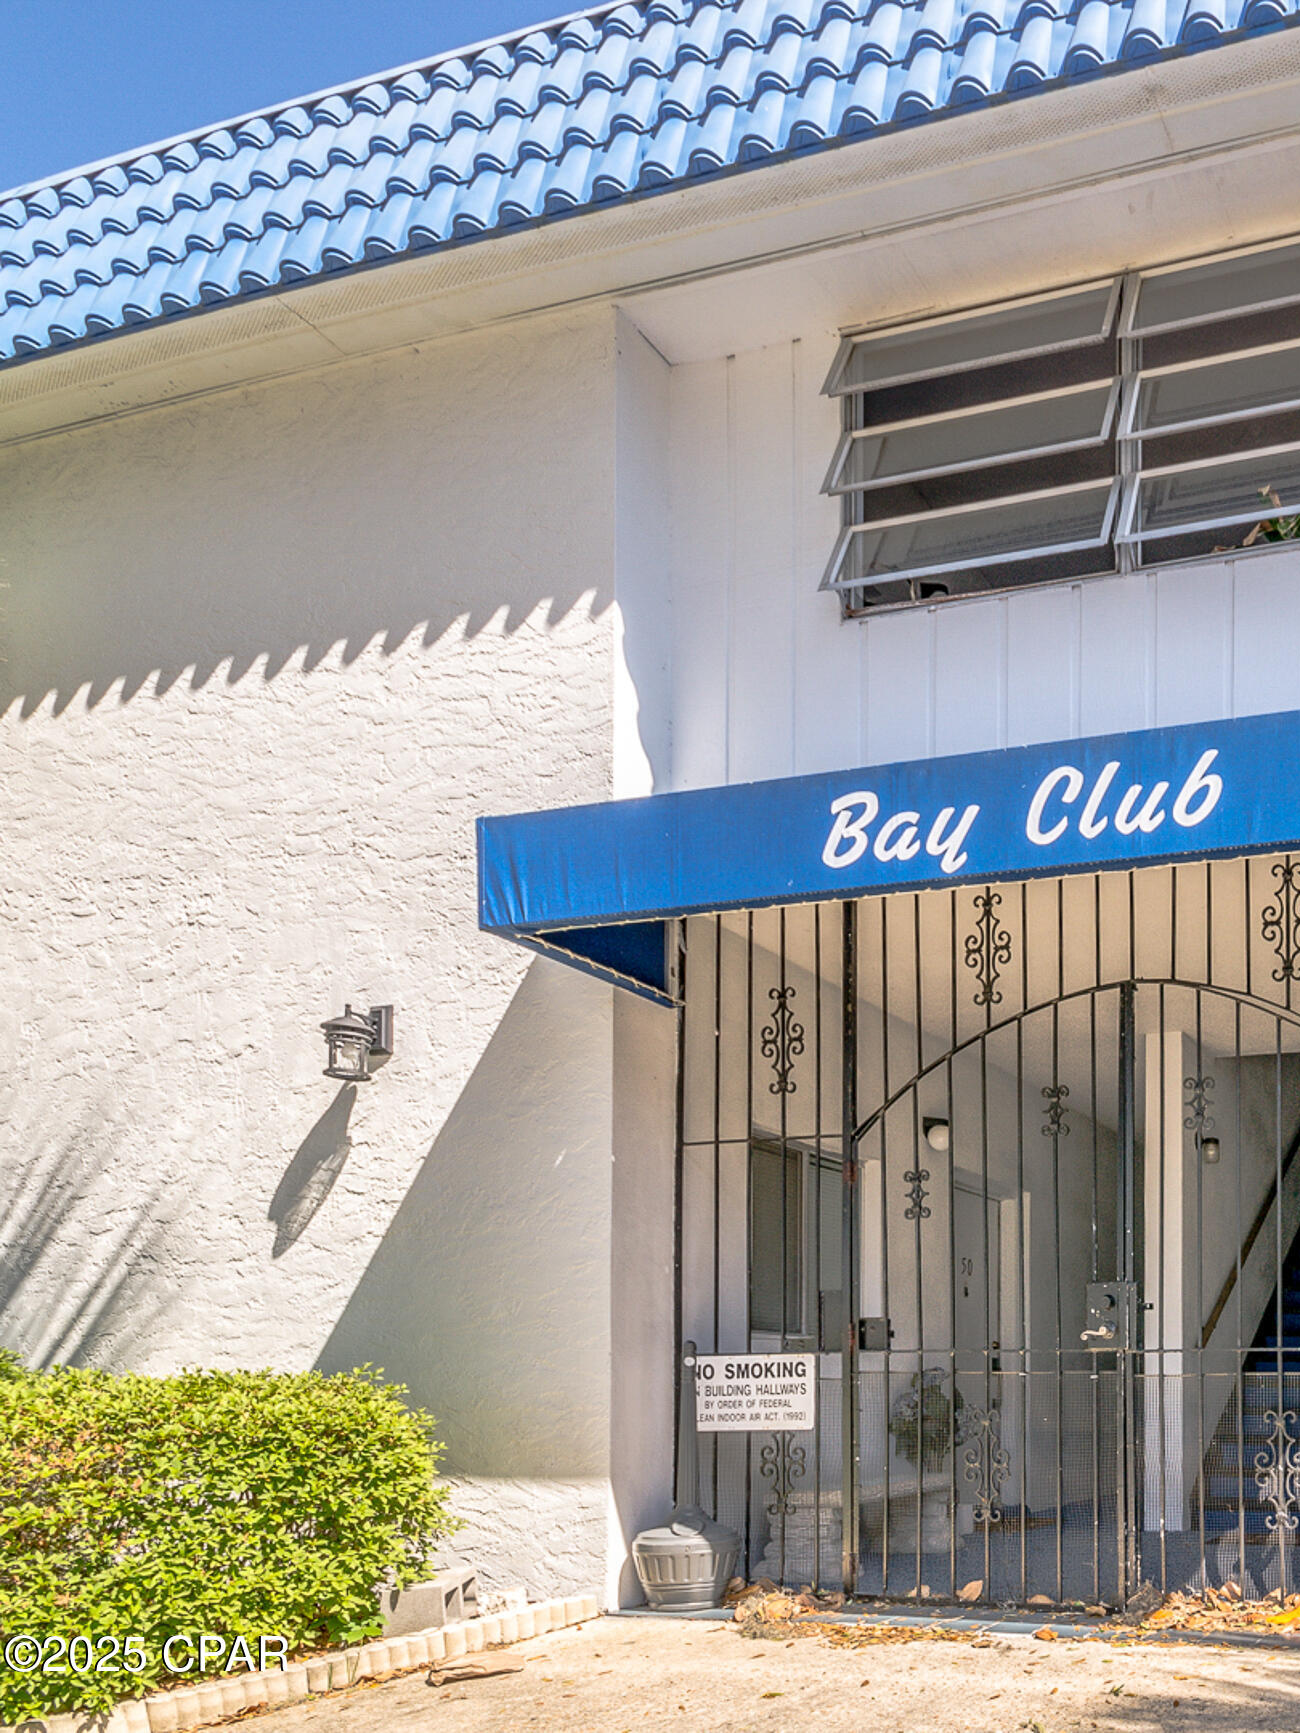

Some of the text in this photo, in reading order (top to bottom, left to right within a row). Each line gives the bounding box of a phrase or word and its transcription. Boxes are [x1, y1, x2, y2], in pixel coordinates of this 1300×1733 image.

[821, 748, 1223, 873] Bay Club
[725, 1361, 806, 1379] SMOKING
[705, 1384, 751, 1397] BUILDING
[756, 1383, 807, 1396] HALLWAYS
[705, 1399, 792, 1410] BY ORDER OF FEDERAL
[697, 1413, 715, 1422] EAN
[718, 1413, 746, 1422] INDOOR
[749, 1413, 761, 1421] AIR
